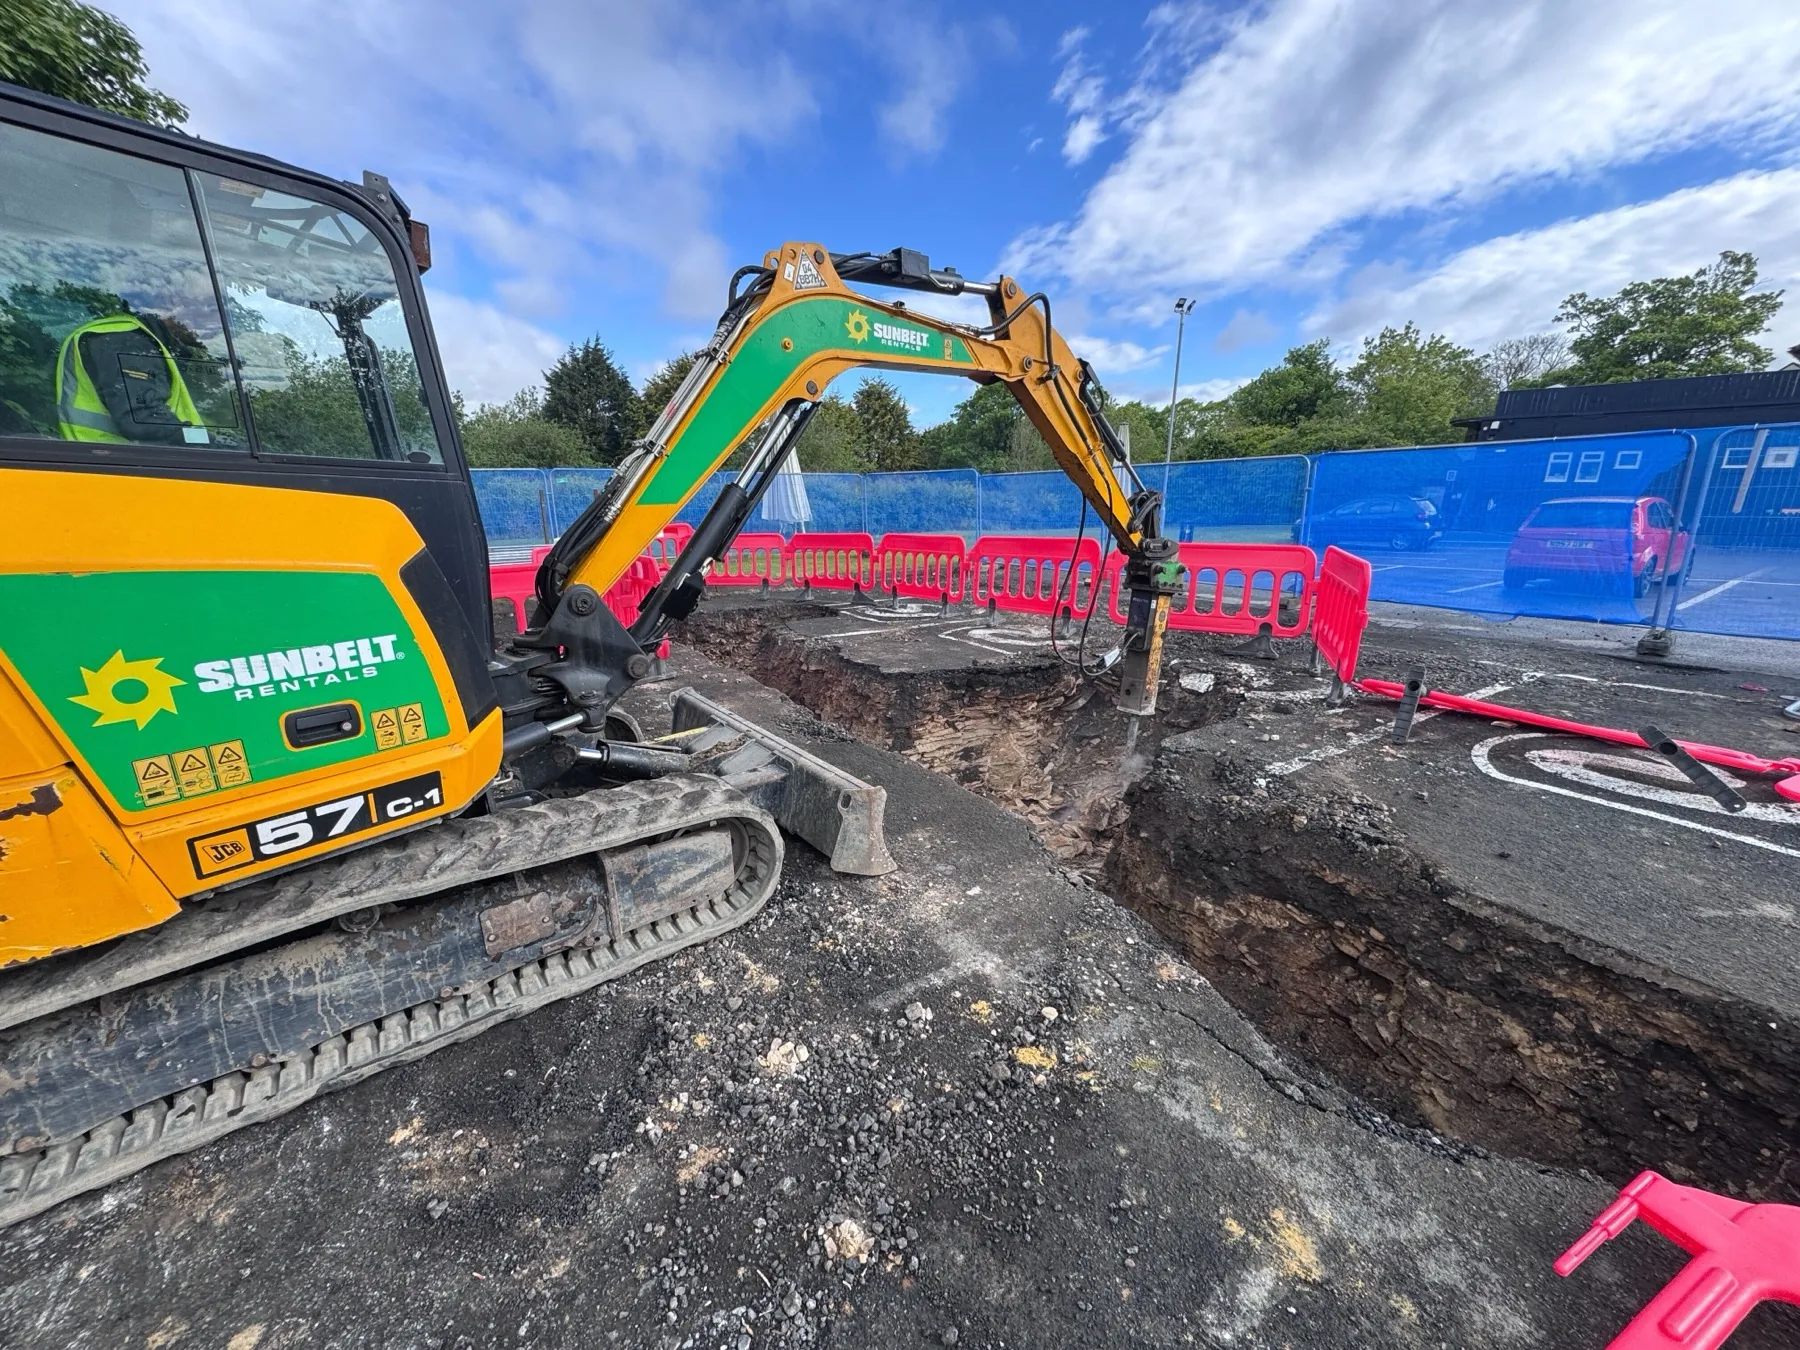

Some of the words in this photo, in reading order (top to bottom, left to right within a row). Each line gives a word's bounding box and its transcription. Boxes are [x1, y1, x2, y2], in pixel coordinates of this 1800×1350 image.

[873, 322, 929, 347] SUNBELT
[881, 338, 921, 352] RENTALS
[194, 634, 398, 693] SUNBELT
[234, 666, 378, 701] RENTALS
[209, 842, 243, 861] JCB
[255, 795, 365, 855] 57
[386, 787, 441, 818] C-1
